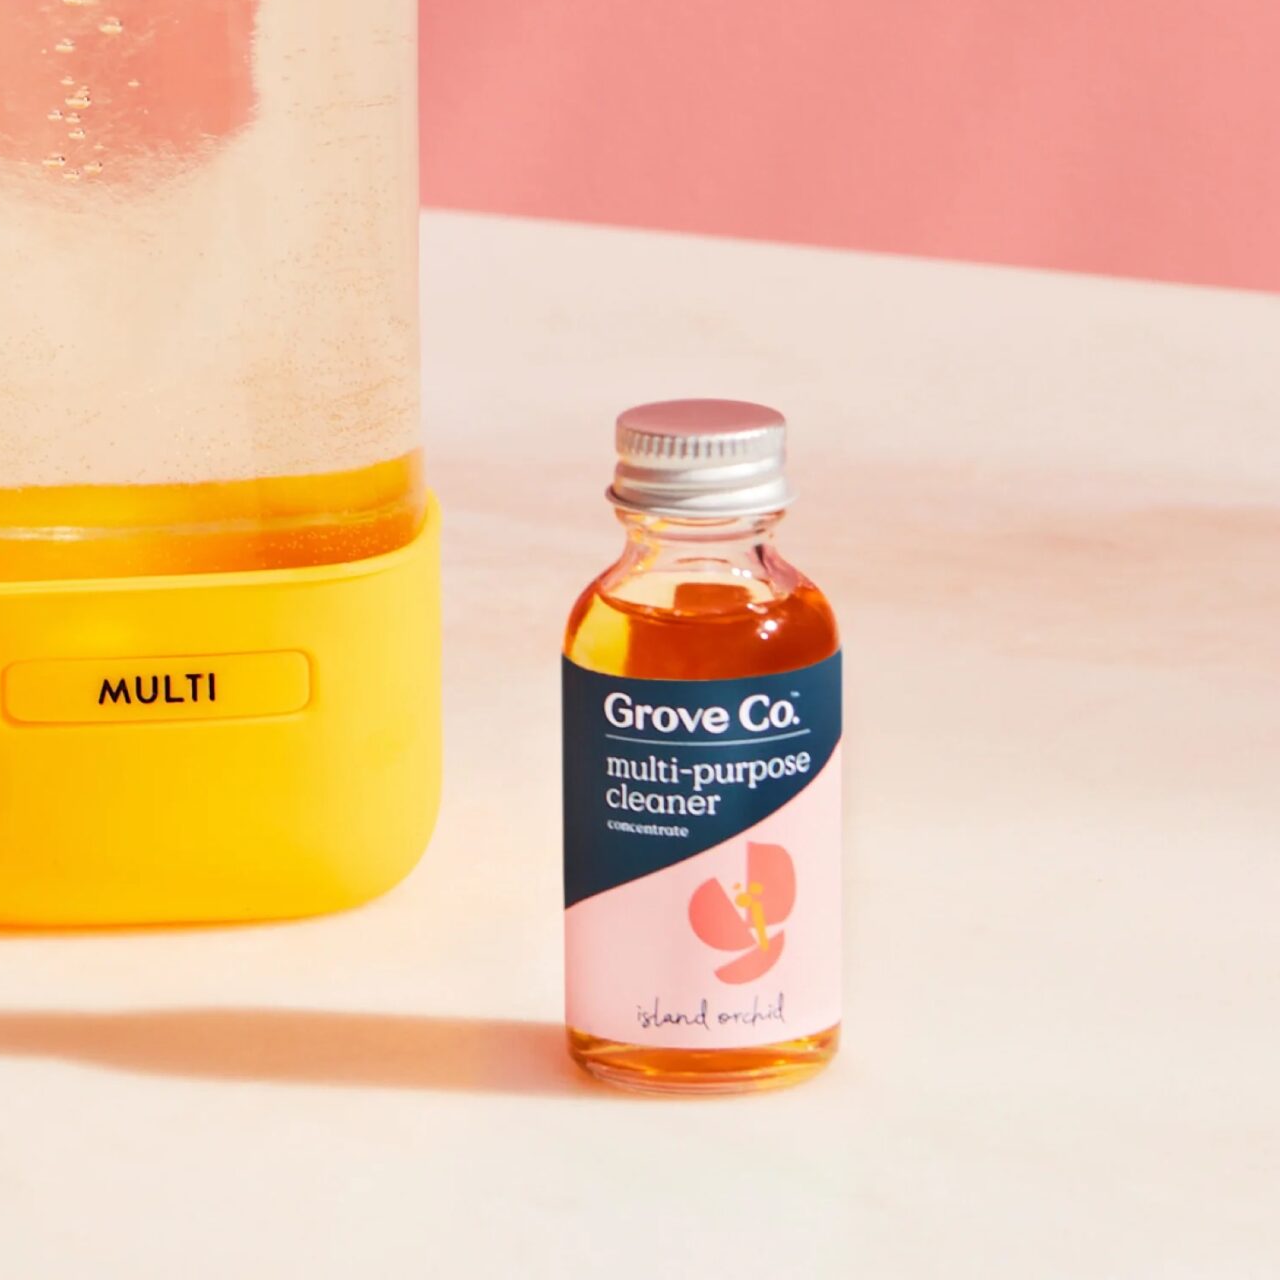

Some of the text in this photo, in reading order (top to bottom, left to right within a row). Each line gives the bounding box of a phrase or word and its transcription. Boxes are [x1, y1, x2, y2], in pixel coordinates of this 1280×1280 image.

[98, 672, 216, 705] MULTI
[604, 692, 800, 734] Grove Co.
[606, 751, 811, 792] multi-purpose
[606, 783, 721, 816] cleaner
[607, 819, 690, 838] concentrate
[636, 992, 785, 1031] island orchid
